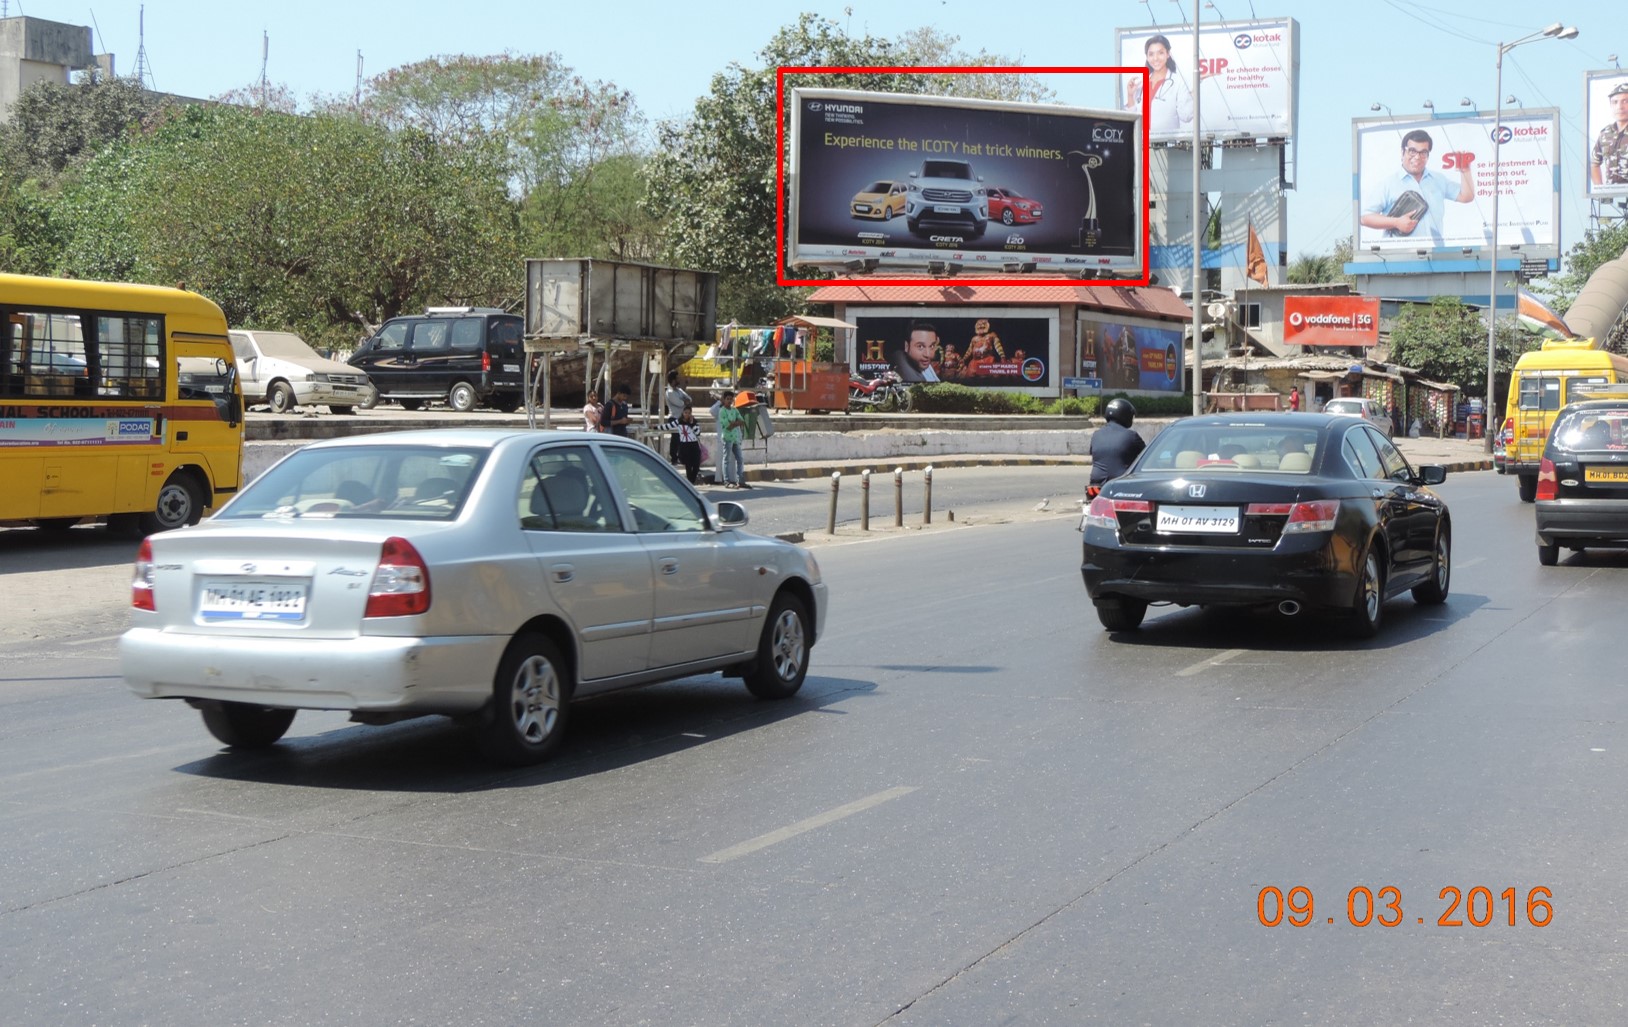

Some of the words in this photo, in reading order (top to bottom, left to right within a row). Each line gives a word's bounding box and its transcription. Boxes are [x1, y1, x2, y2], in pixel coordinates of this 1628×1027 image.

[1253, 33, 1281, 42] kotak
[1199, 58, 1228, 75] SIP
[1238, 74, 1265, 82] healthy
[1227, 82, 1271, 90] investments.
[824, 103, 863, 114] HYUNDAI
[1513, 126, 1548, 136] kotak
[824, 132, 894, 150] Experience
[898, 138, 918, 151] the
[921, 139, 959, 153] ICOTY
[962, 142, 982, 156] hat
[985, 144, 1013, 157] trick
[1015, 147, 1064, 160] winners.
[1537, 158, 1548, 166] ka
[1510, 169, 1527, 177] out,
[1477, 189, 1503, 197] dhyn
[929, 235, 964, 243] CRETA
[1304, 313, 1350, 324] vodafone
[1357, 314, 1371, 324] 3G
[120, 423, 150, 432] PODAR
[1161, 517, 1178, 525] MH
[1195, 518, 1208, 526] AV
[1211, 518, 1235, 526] 3129
